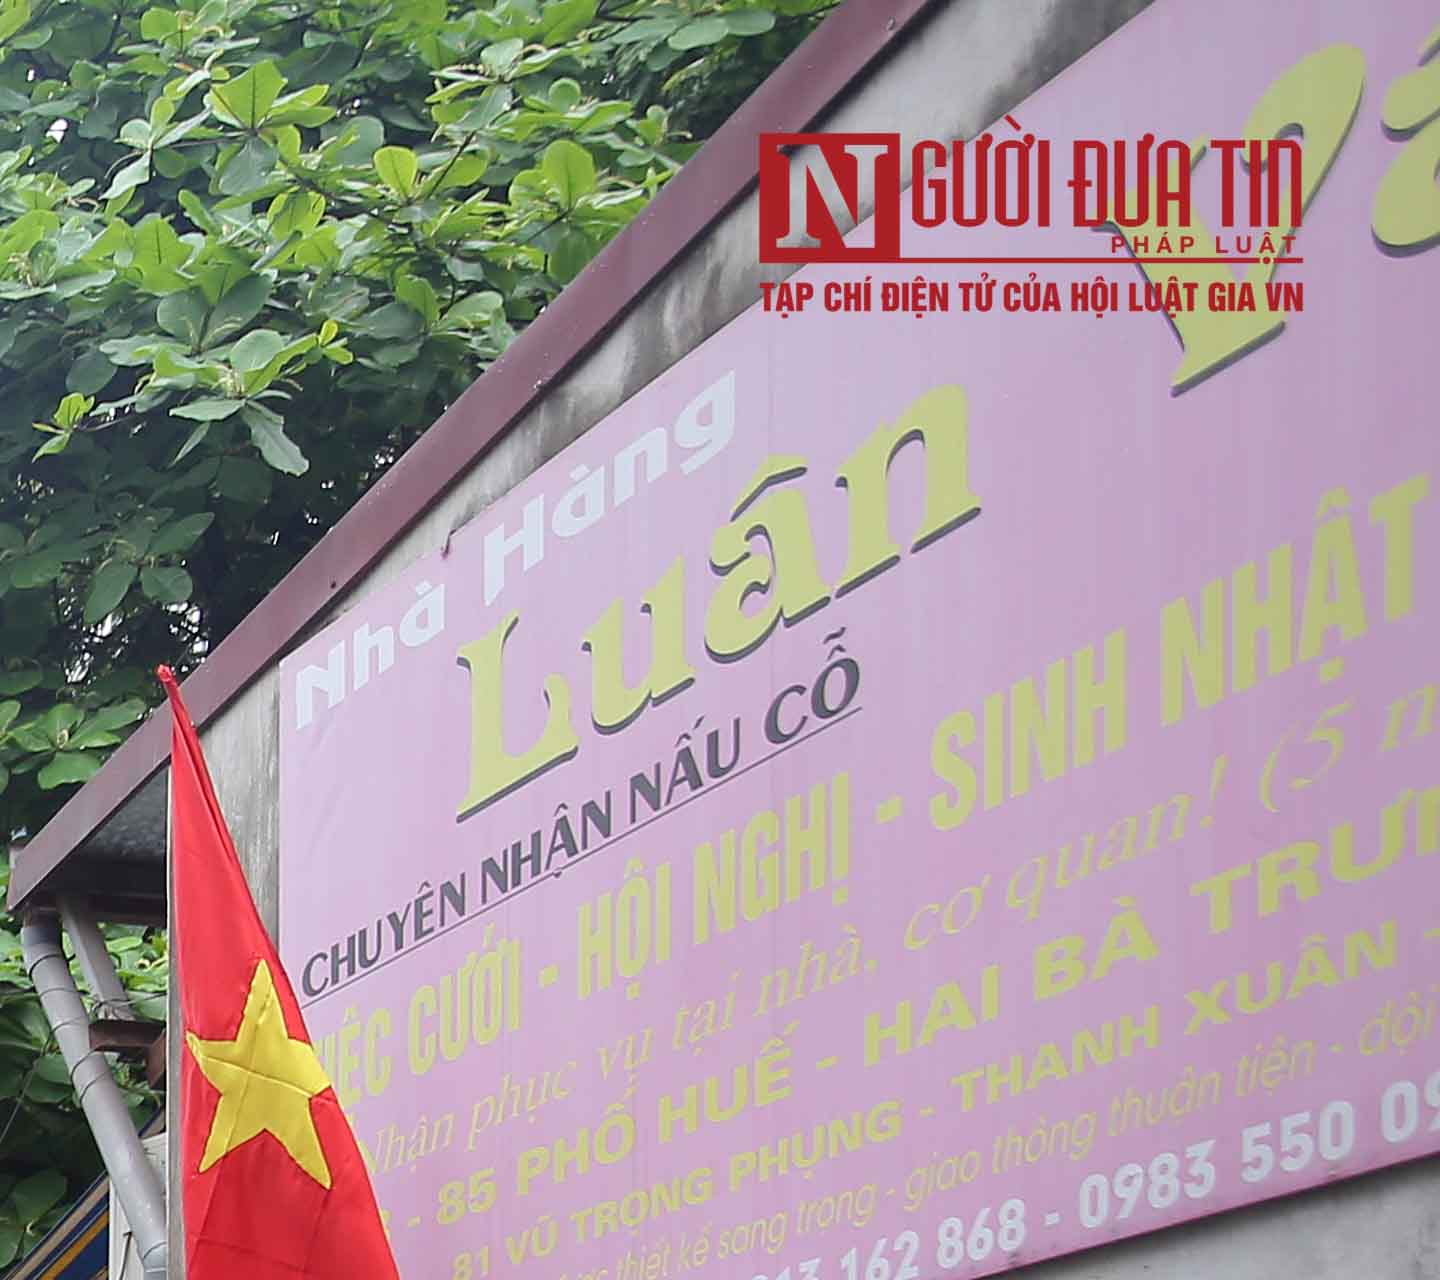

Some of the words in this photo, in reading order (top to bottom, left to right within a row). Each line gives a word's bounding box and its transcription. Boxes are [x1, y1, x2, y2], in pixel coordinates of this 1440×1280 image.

[296, 580, 447, 731] Nhà
[482, 369, 736, 607] Hàng
[456, 383, 981, 824] Luân
[301, 872, 467, 998] CHUYÊN
[480, 789, 613, 880] NHẬN
[628, 714, 742, 824] NẤU
[763, 625, 862, 745] CỖ
[578, 855, 672, 1000] HỘI
[693, 770, 851, 946] NGHỊ
[929, 627, 1127, 831] SINH
[1159, 471, 1431, 728] NHẬT
[436, 1166, 498, 1226] 85
[516, 1072, 639, 1197] PHỐ
[657, 1017, 801, 1144] HUẾ
[862, 963, 1001, 1069] HAI
[1032, 895, 1160, 1001] BÀ
[569, 1165, 714, 1241] TRỌNG
[727, 1098, 904, 1193] PHỤNG
[950, 1003, 1161, 1116] THANH
[1183, 918, 1399, 1038] XUÂN
[936, 1196, 1026, 1270] 868
[1079, 1137, 1218, 1231] 0983
[1240, 1098, 1356, 1185] 550
